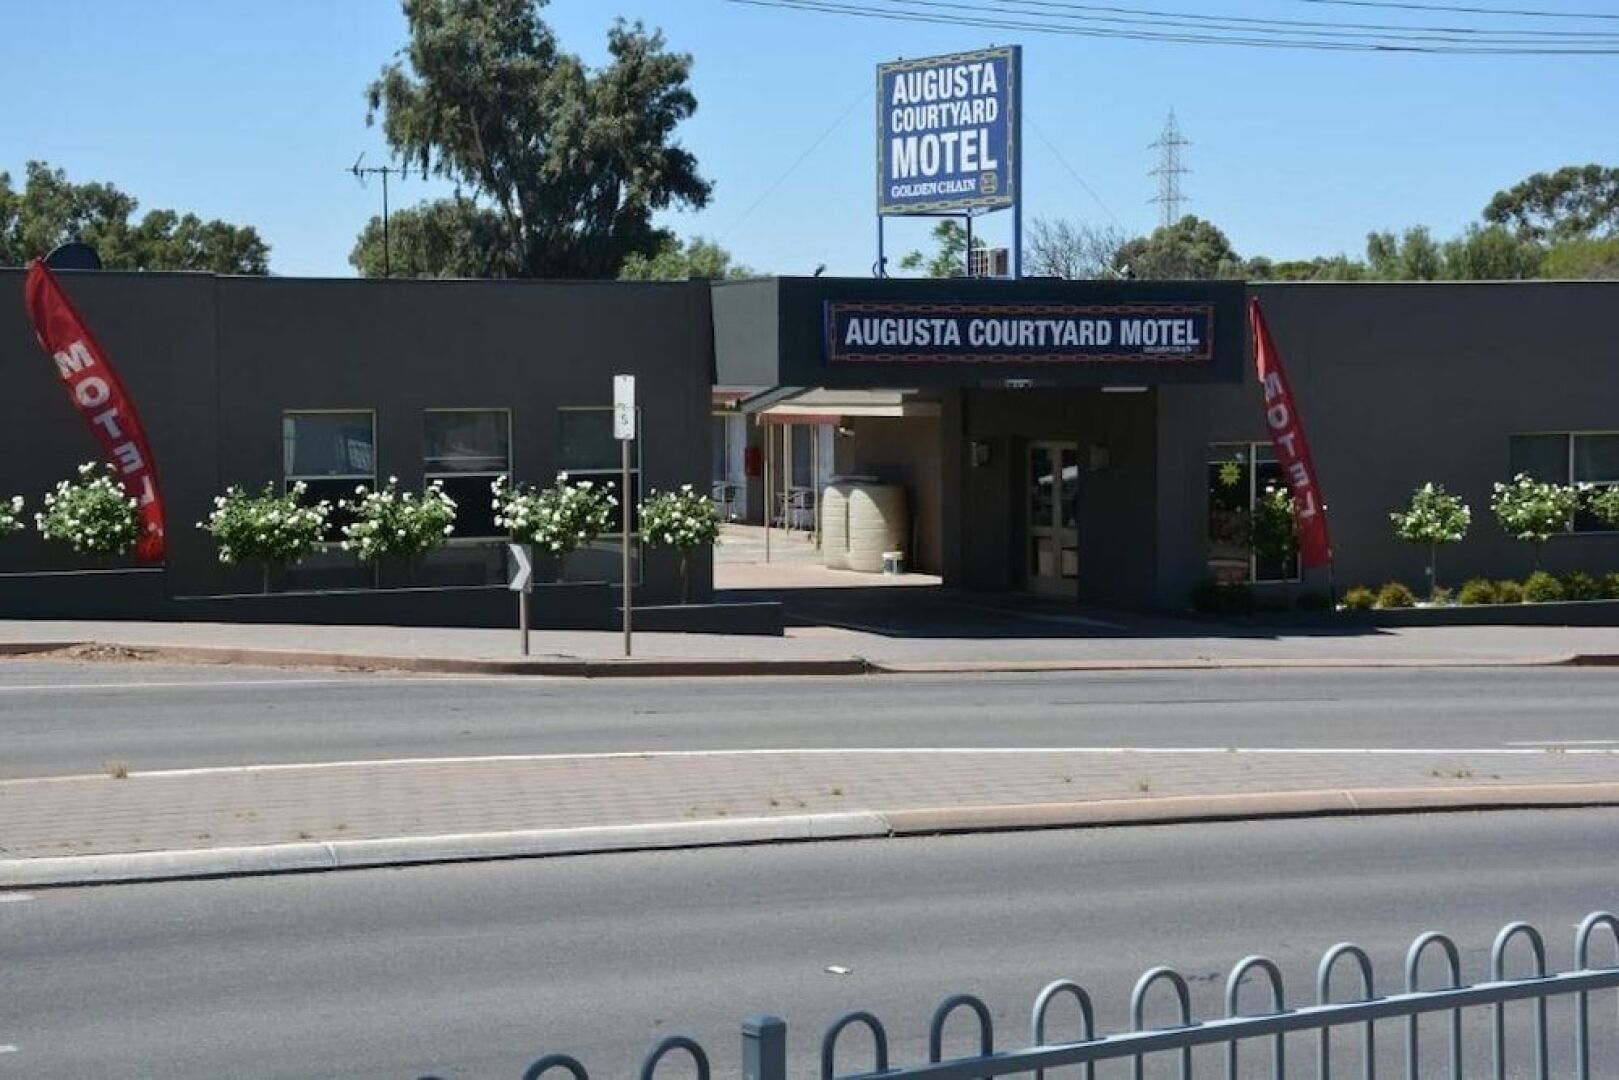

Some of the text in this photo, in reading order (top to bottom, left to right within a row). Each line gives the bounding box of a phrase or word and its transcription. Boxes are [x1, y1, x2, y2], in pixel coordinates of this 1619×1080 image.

[892, 62, 998, 105] AUGUSTA
[891, 97, 998, 134] COURTYARD
[891, 128, 998, 179] MOTEL
[845, 317, 1200, 347] AUGUSTA COURTYARD MOTEL
